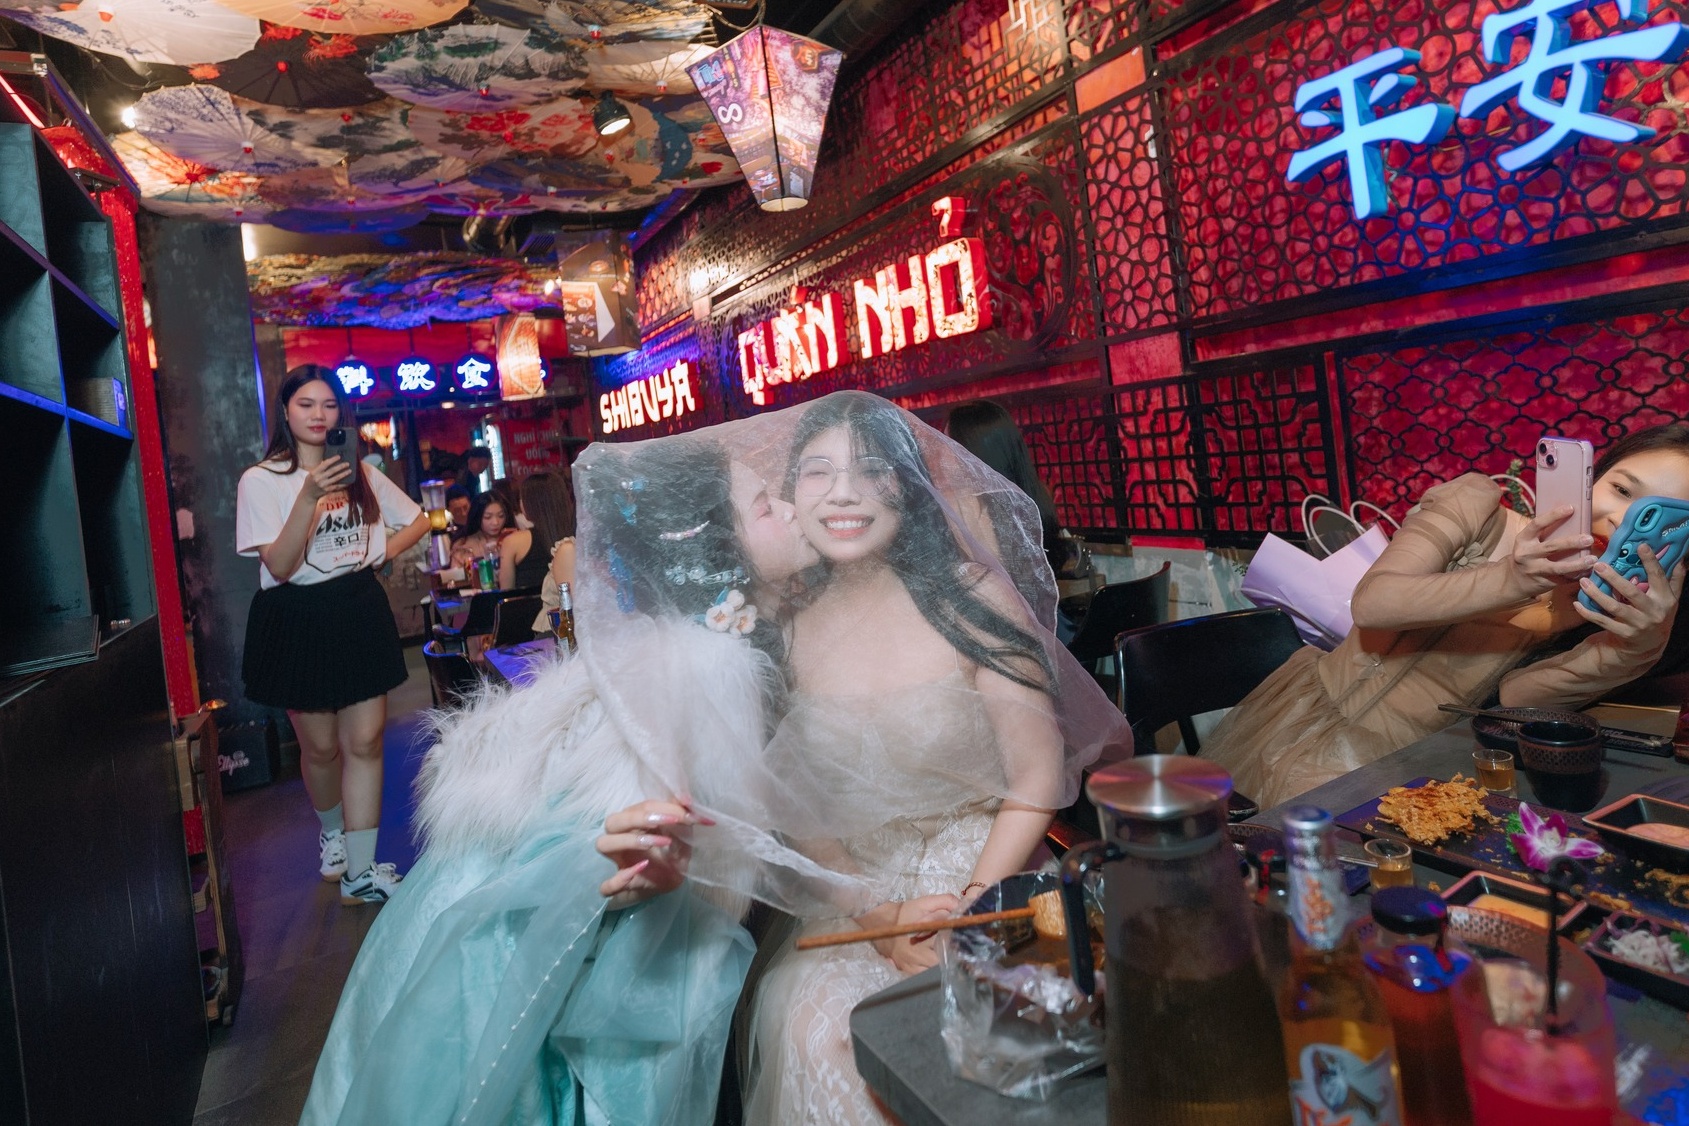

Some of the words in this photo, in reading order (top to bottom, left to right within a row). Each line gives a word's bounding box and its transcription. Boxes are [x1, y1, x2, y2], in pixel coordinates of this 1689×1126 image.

[1286, 0, 1684, 220] 平安
[738, 286, 841, 406] QUÁN
[854, 196, 984, 360] NHỎ
[600, 358, 696, 434] SHIBUYA
[334, 532, 359, 546] 辛口
